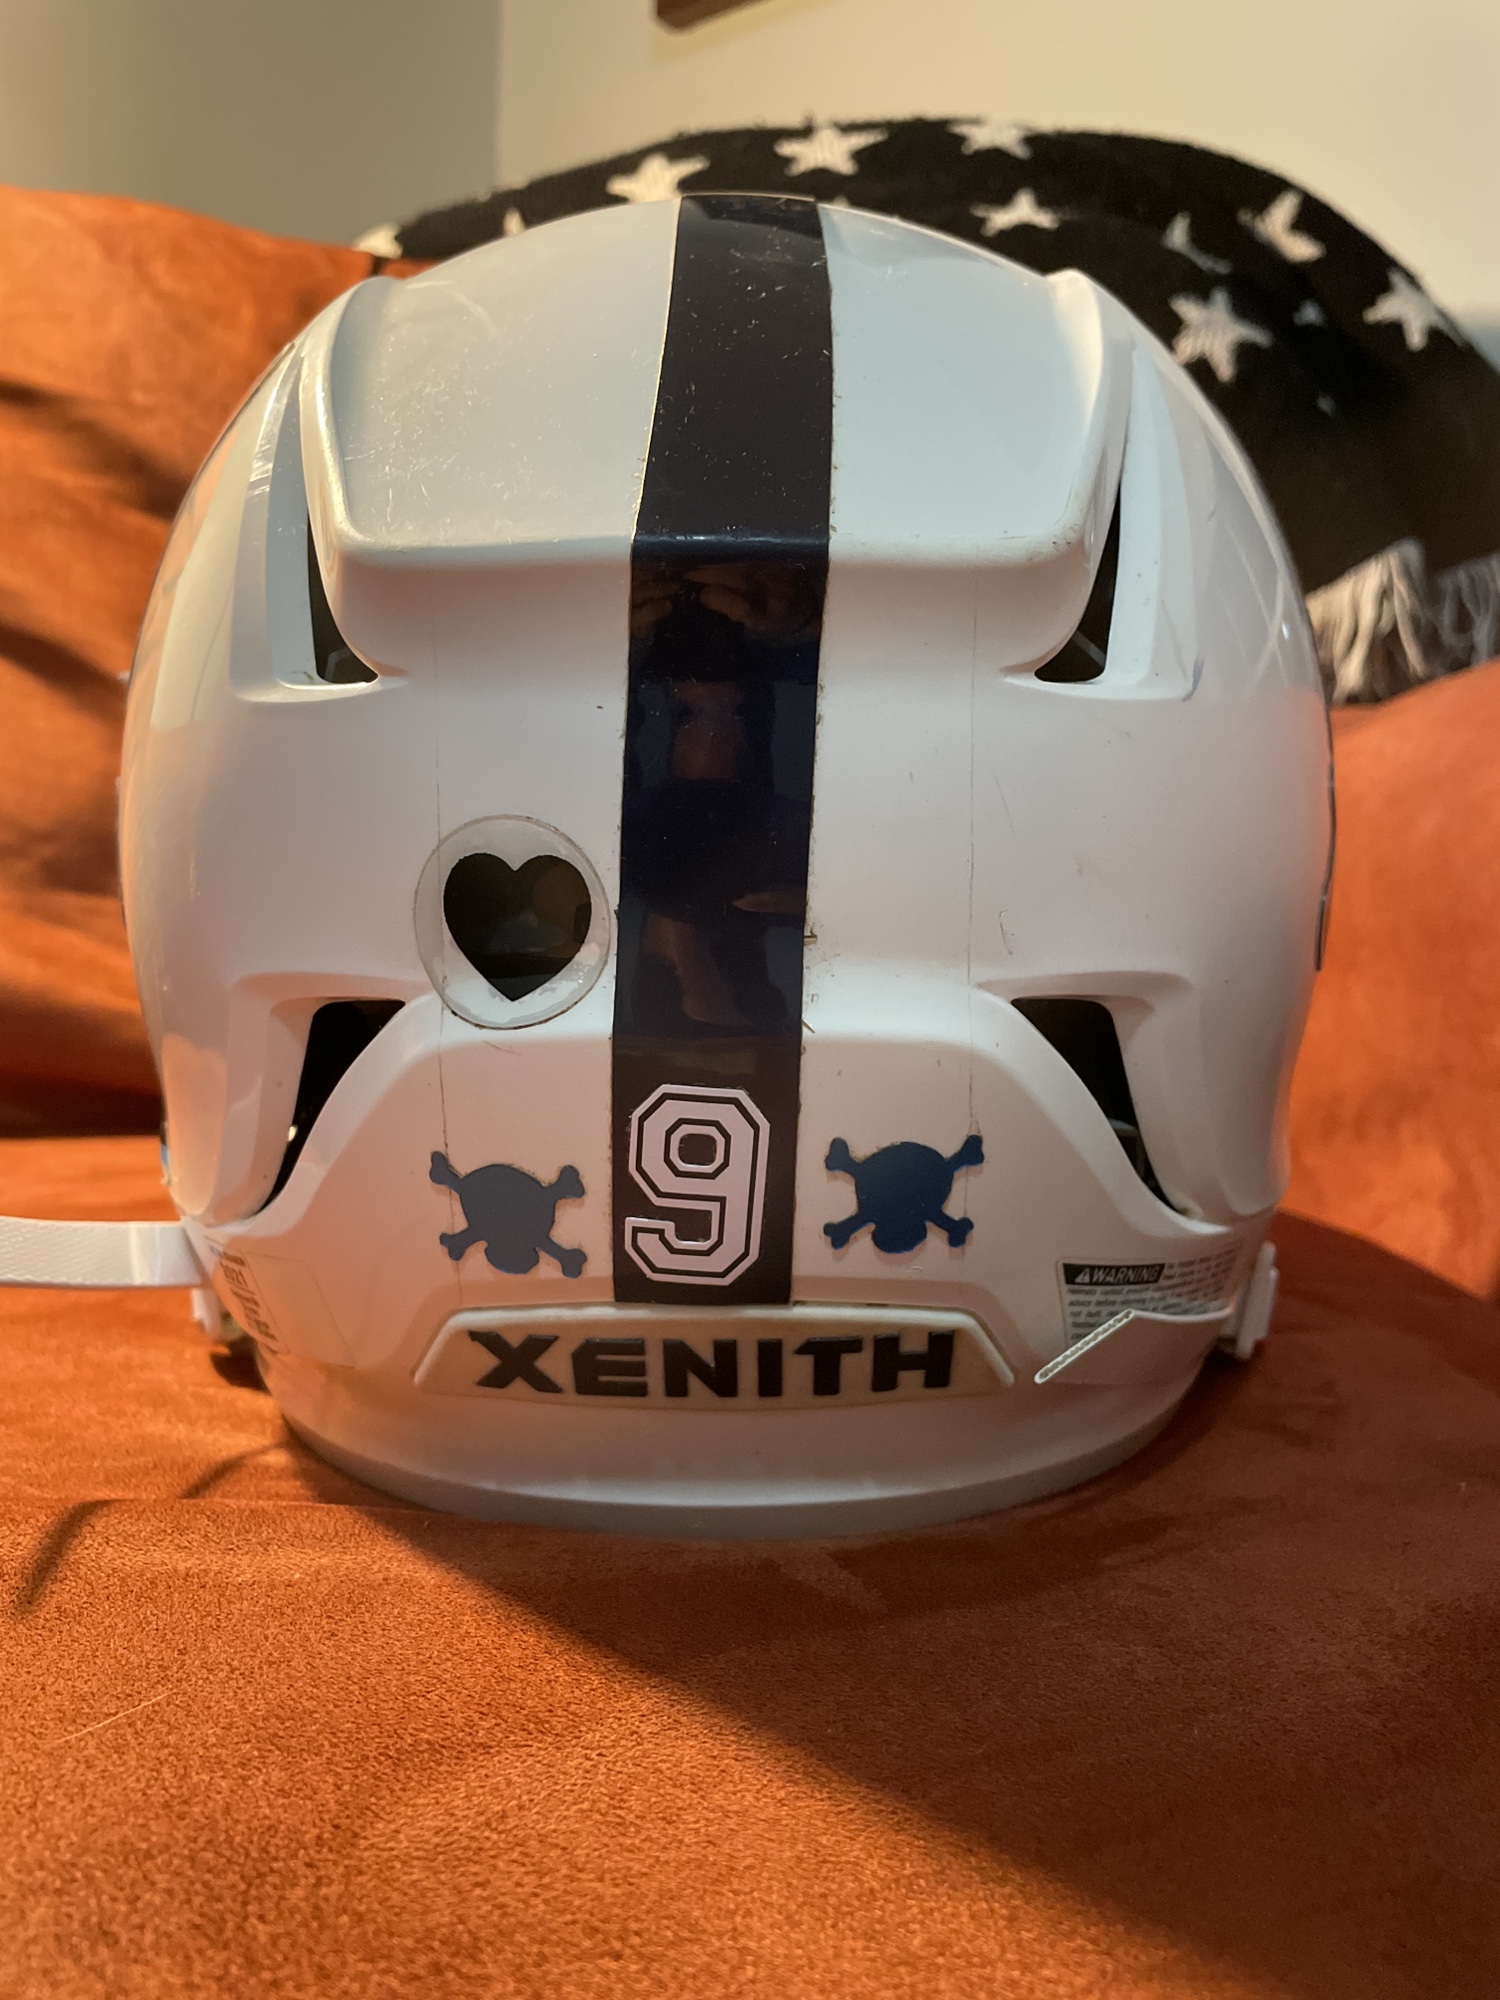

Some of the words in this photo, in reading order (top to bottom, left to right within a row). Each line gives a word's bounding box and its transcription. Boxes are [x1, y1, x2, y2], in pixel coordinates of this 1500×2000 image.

[624, 1084, 771, 1287] 9
[1091, 1266, 1161, 1284] WARNING
[467, 1330, 956, 1398] XENITH
